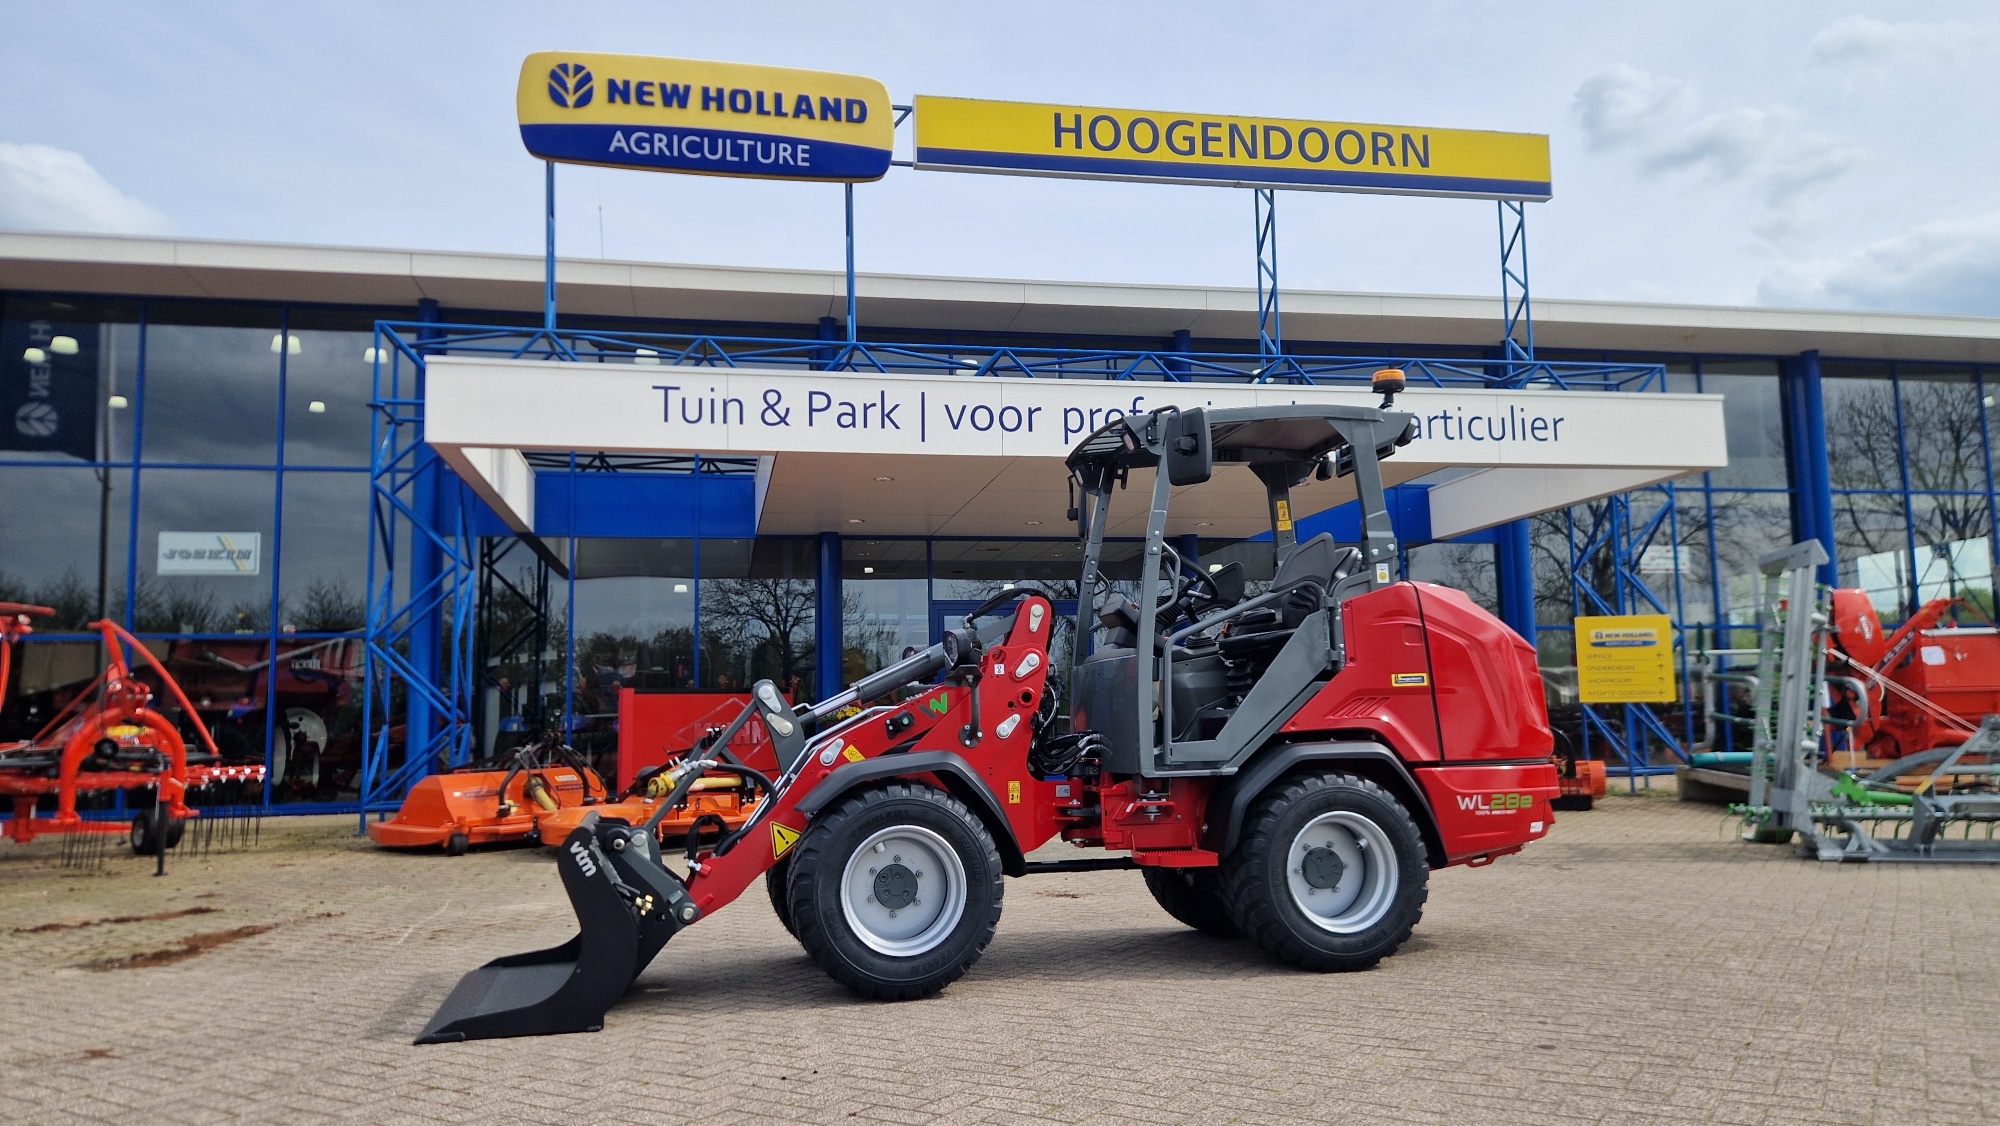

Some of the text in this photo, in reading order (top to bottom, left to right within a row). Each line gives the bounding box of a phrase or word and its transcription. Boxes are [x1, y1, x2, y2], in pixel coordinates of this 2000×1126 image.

[607, 78, 867, 124] NEW HOLLAND
[608, 130, 810, 167] AGRICULTURE
[1052, 111, 1431, 169] HOOGENDOORN
[652, 385, 744, 425] Tuin
[760, 388, 791, 427] &
[808, 389, 901, 430] Park
[944, 403, 1042, 433] voor
[1408, 404, 1565, 442] articulier
[1456, 793, 1533, 810] WL28e
[570, 841, 597, 877] vtm
